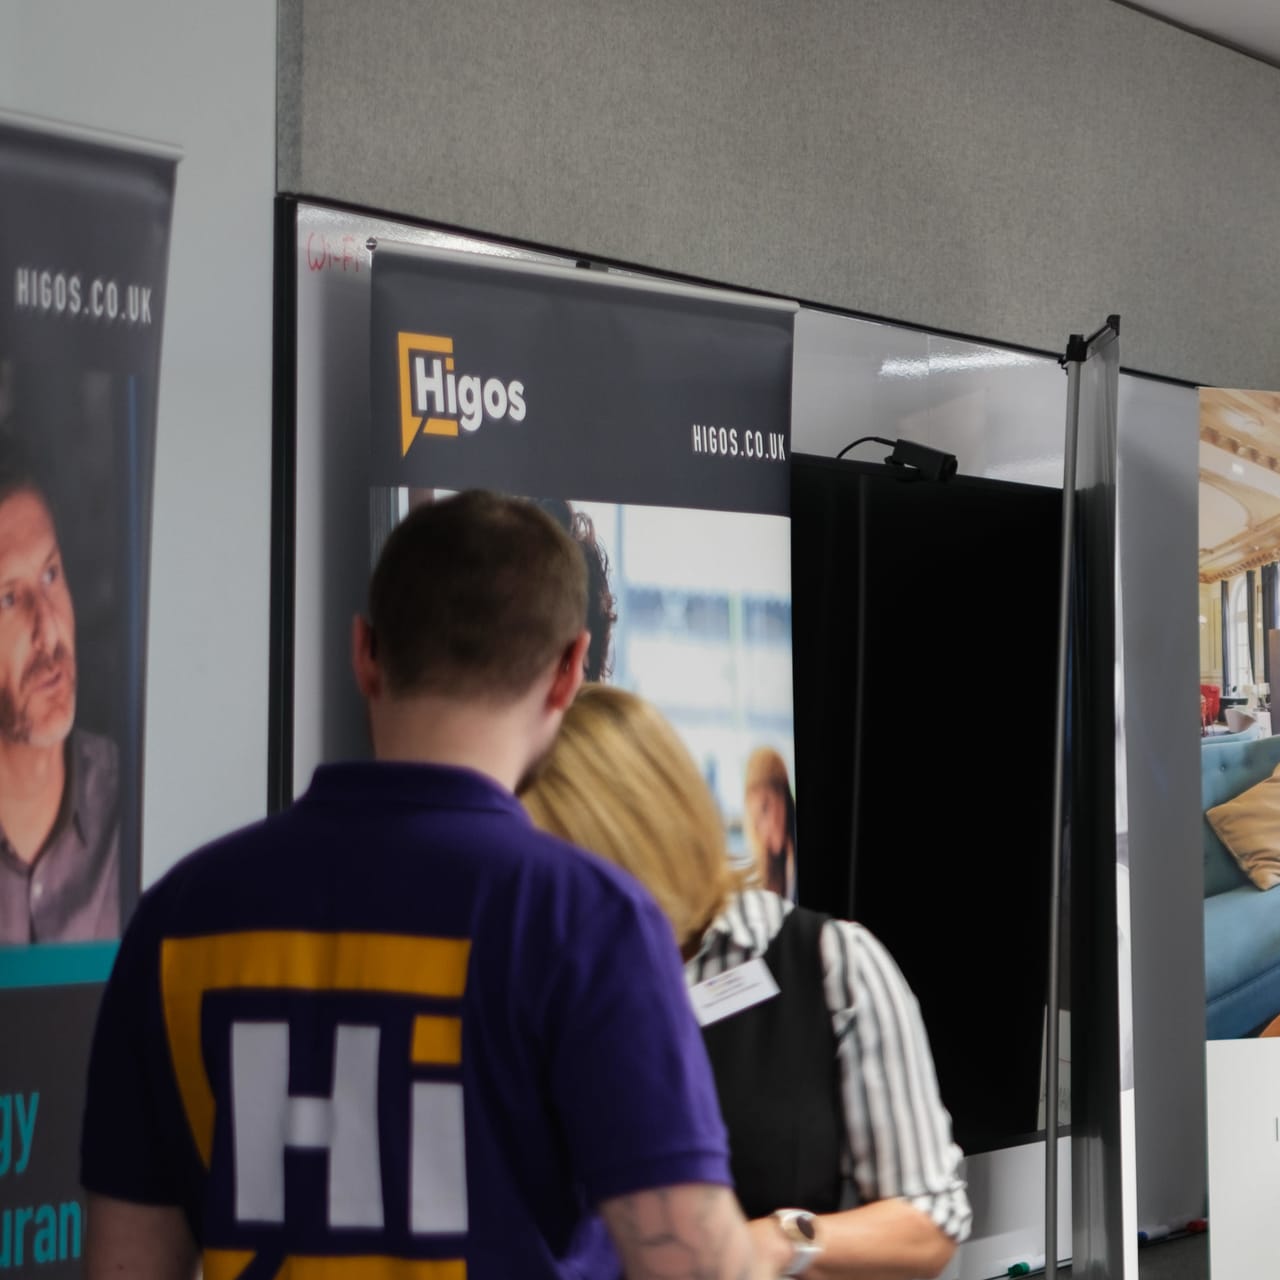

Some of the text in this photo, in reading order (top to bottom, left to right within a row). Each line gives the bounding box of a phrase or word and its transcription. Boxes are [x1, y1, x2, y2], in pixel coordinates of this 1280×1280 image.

[16, 267, 153, 324] HIGOS.CO.UK
[415, 356, 527, 432] Higos
[693, 424, 786, 461] HIGOS.CO.UK
[231, 1014, 468, 1235] Hi
